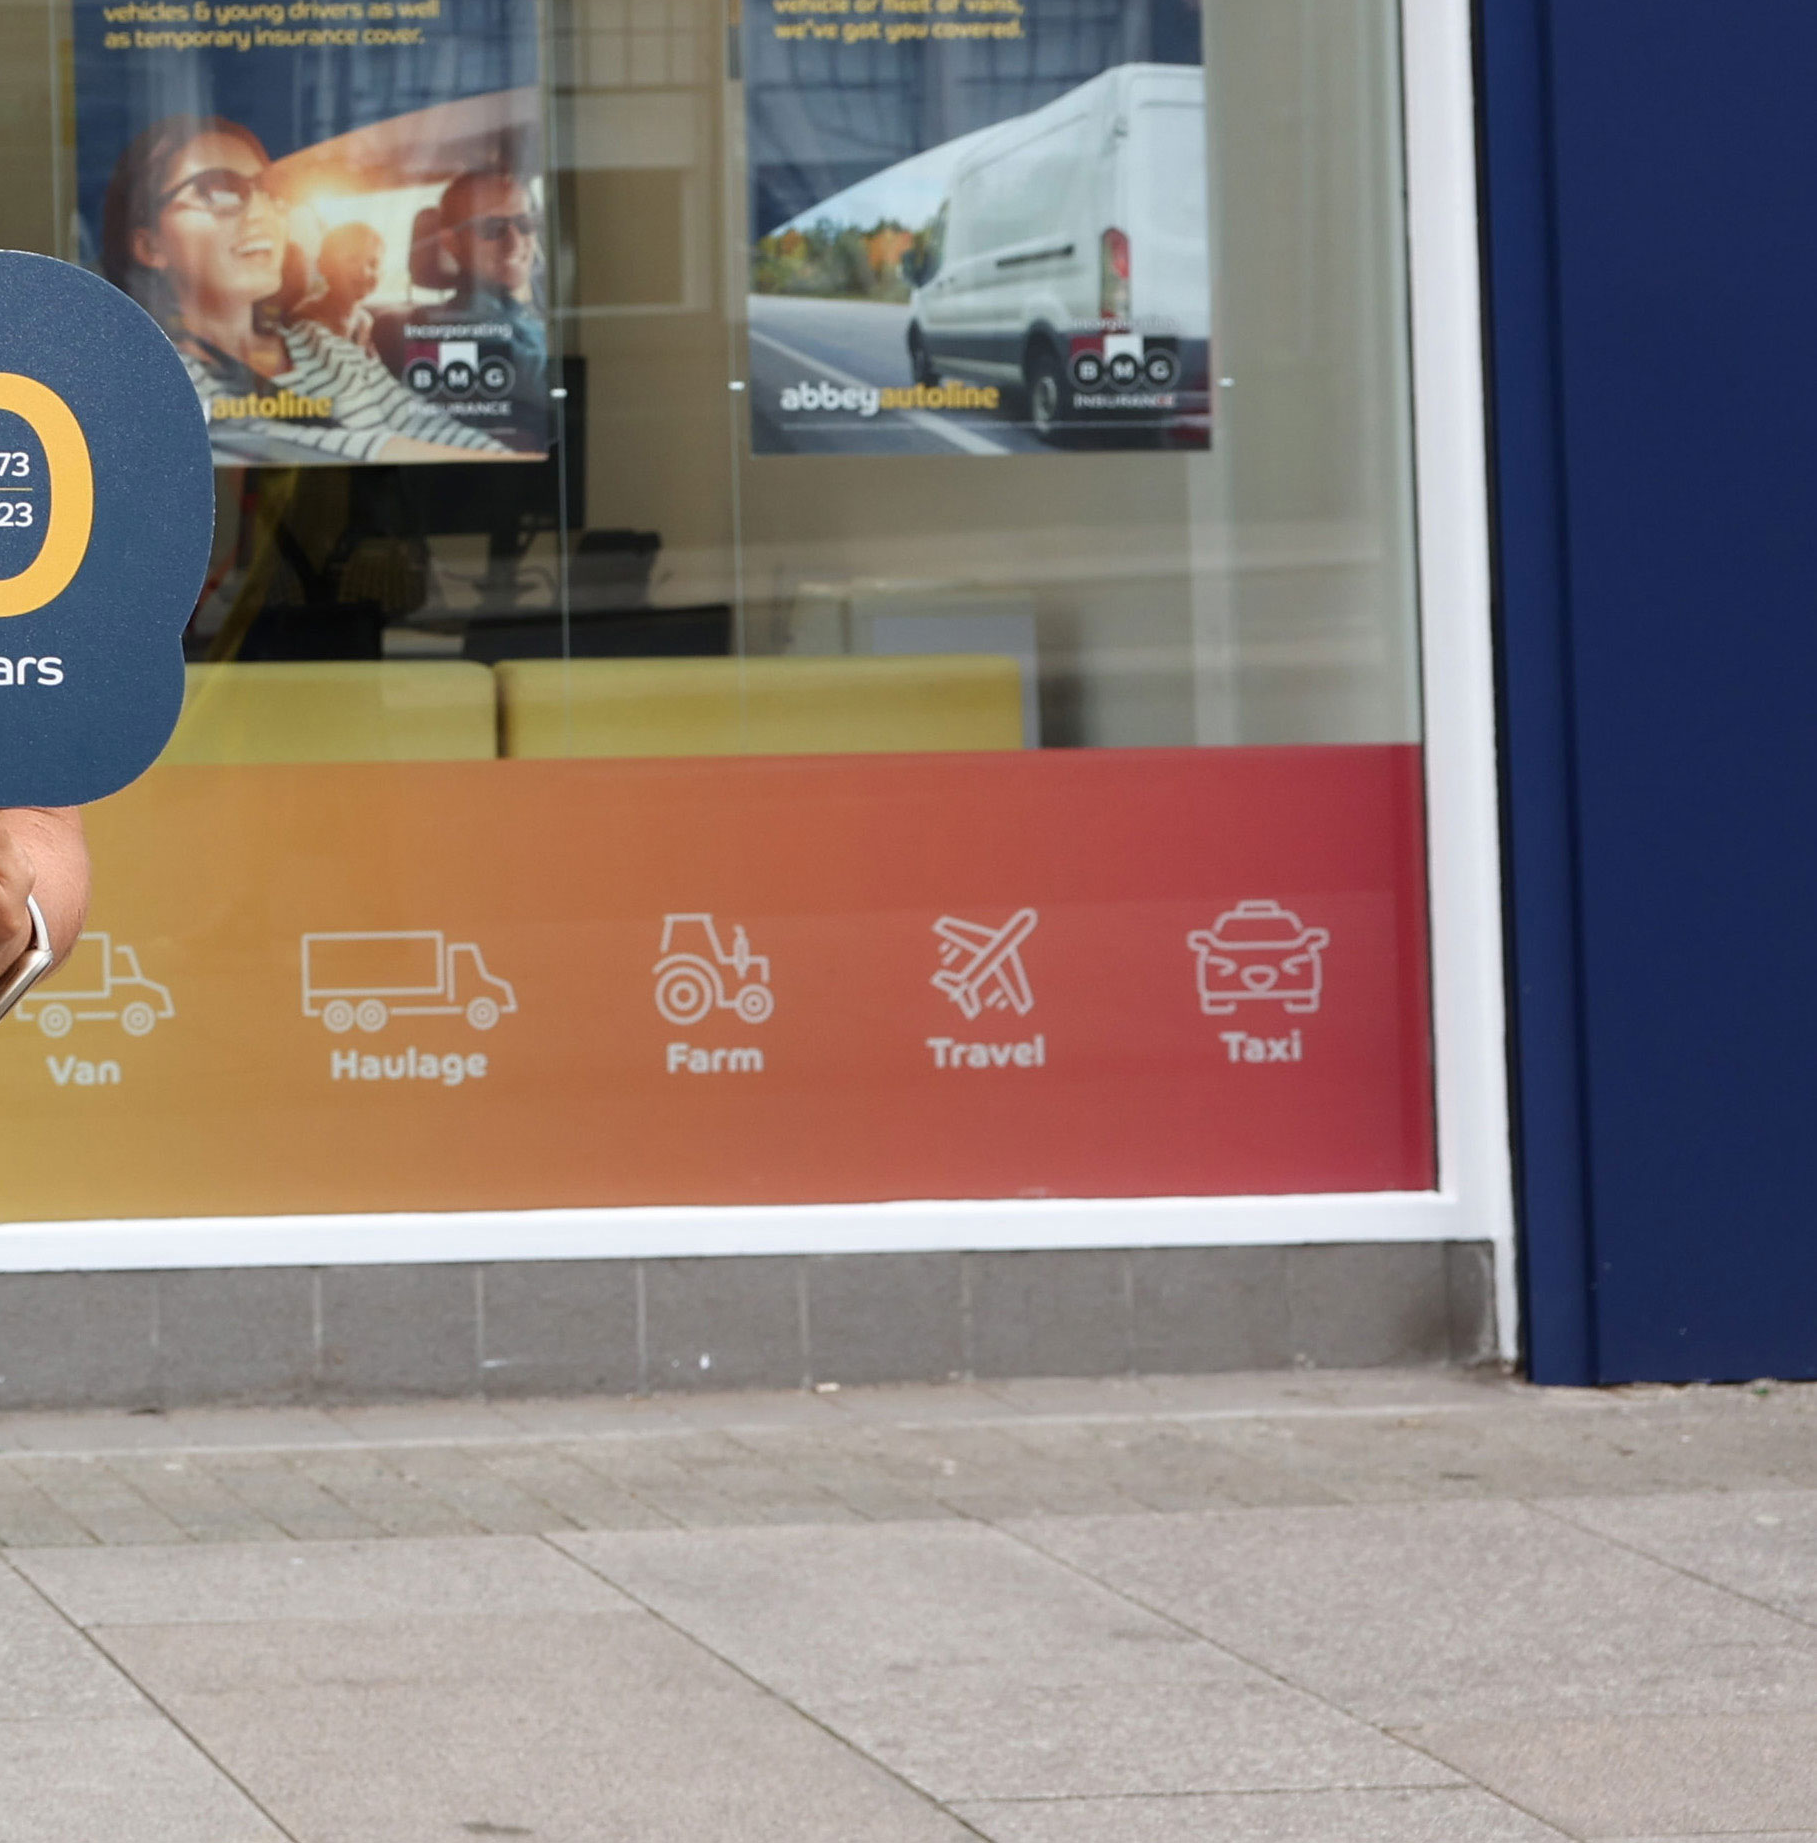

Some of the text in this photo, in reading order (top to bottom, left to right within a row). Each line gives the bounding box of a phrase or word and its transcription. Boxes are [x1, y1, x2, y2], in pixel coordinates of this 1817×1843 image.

[103, 2, 190, 23] vehicles
[214, 3, 285, 26] young
[288, 0, 364, 21] drivers
[367, 2, 393, 19] as
[103, 26, 425, 52] as temporary insurance cover.
[842, 19, 882, 44] got
[885, 23, 929, 43] you
[931, 18, 1025, 39] covered.
[404, 322, 513, 342] Incorporating
[666, 1041, 764, 1075] Farm
[926, 1034, 1045, 1070] Travel
[1221, 1029, 1302, 1064] Taxi
[47, 1054, 120, 1087] Van
[331, 1047, 488, 1086] Haulage
